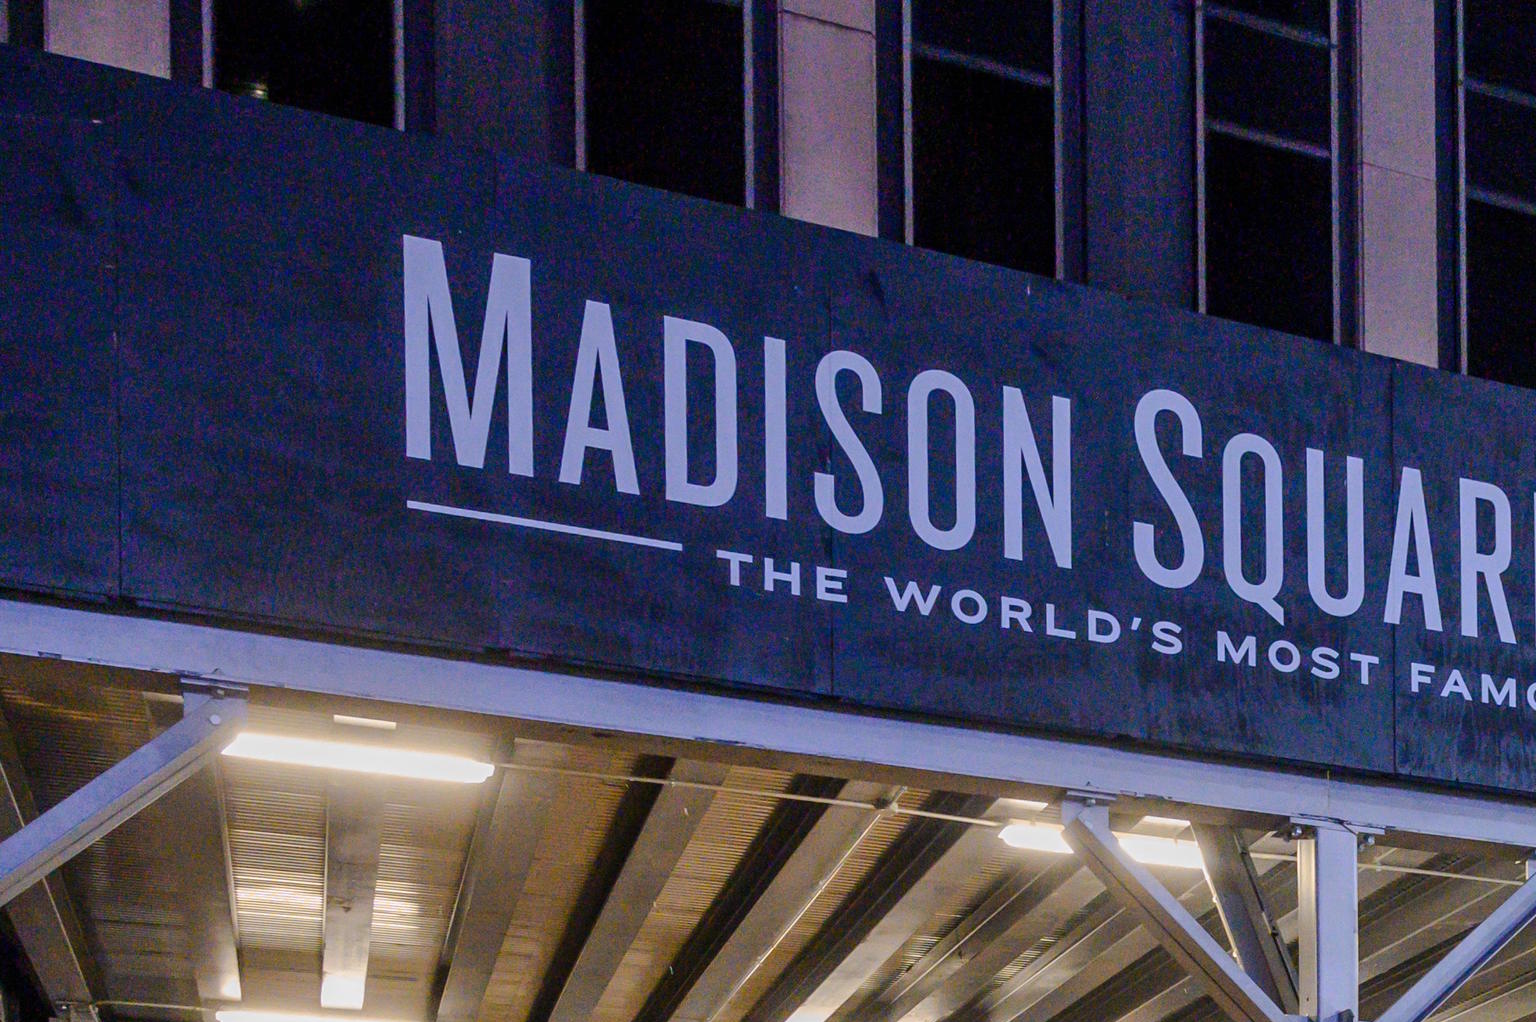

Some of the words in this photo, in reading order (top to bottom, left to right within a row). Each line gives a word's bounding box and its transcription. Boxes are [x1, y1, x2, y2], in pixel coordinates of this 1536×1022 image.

[403, 234, 1073, 570] MADISON
[717, 549, 849, 603] THE
[884, 576, 1183, 655] WORLD'S
[1216, 630, 1380, 687] MOST
